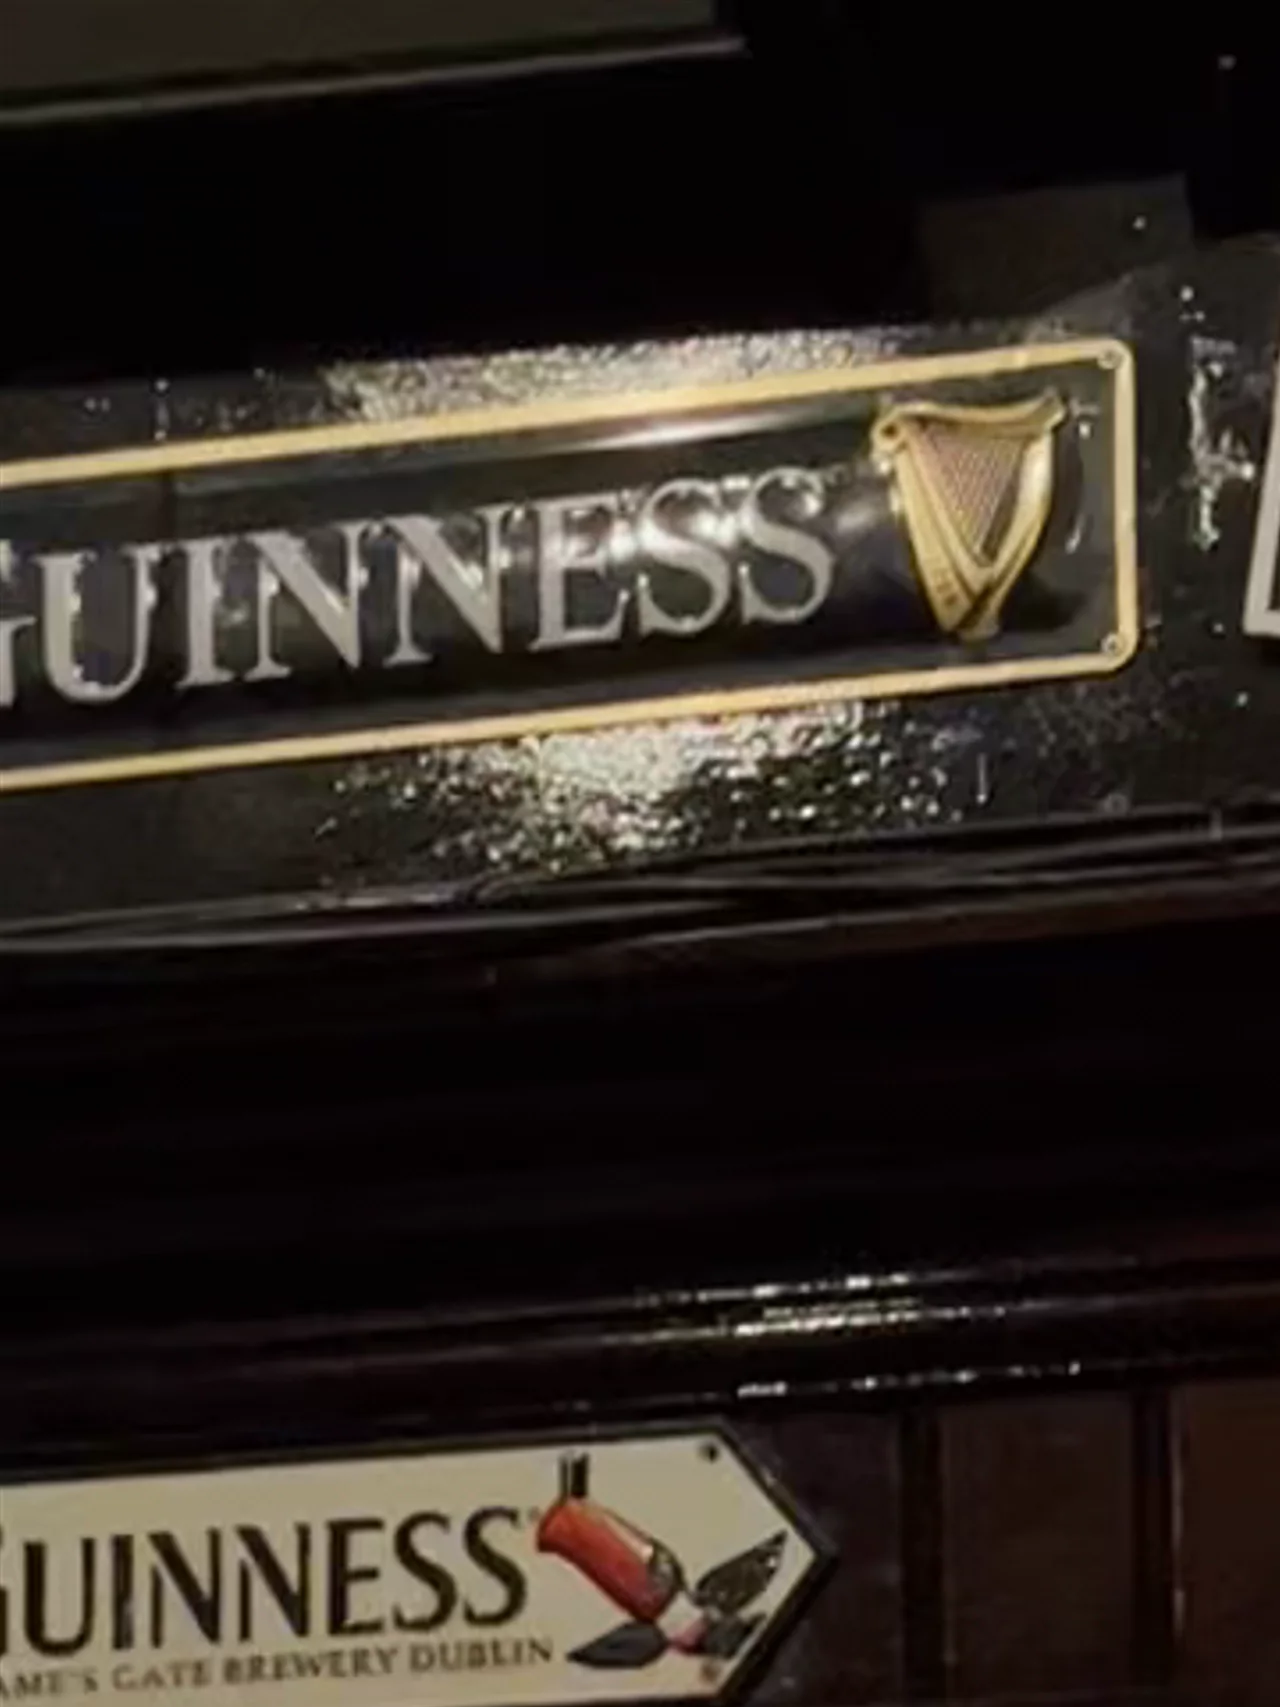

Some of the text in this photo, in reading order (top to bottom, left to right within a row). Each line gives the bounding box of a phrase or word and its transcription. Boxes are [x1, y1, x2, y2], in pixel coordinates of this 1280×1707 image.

[0, 1506, 527, 1658] UINNESS
[111, 1659, 210, 1692] GATE
[223, 1647, 398, 1685] BREWERY
[410, 1637, 554, 1674] DUBLIN
